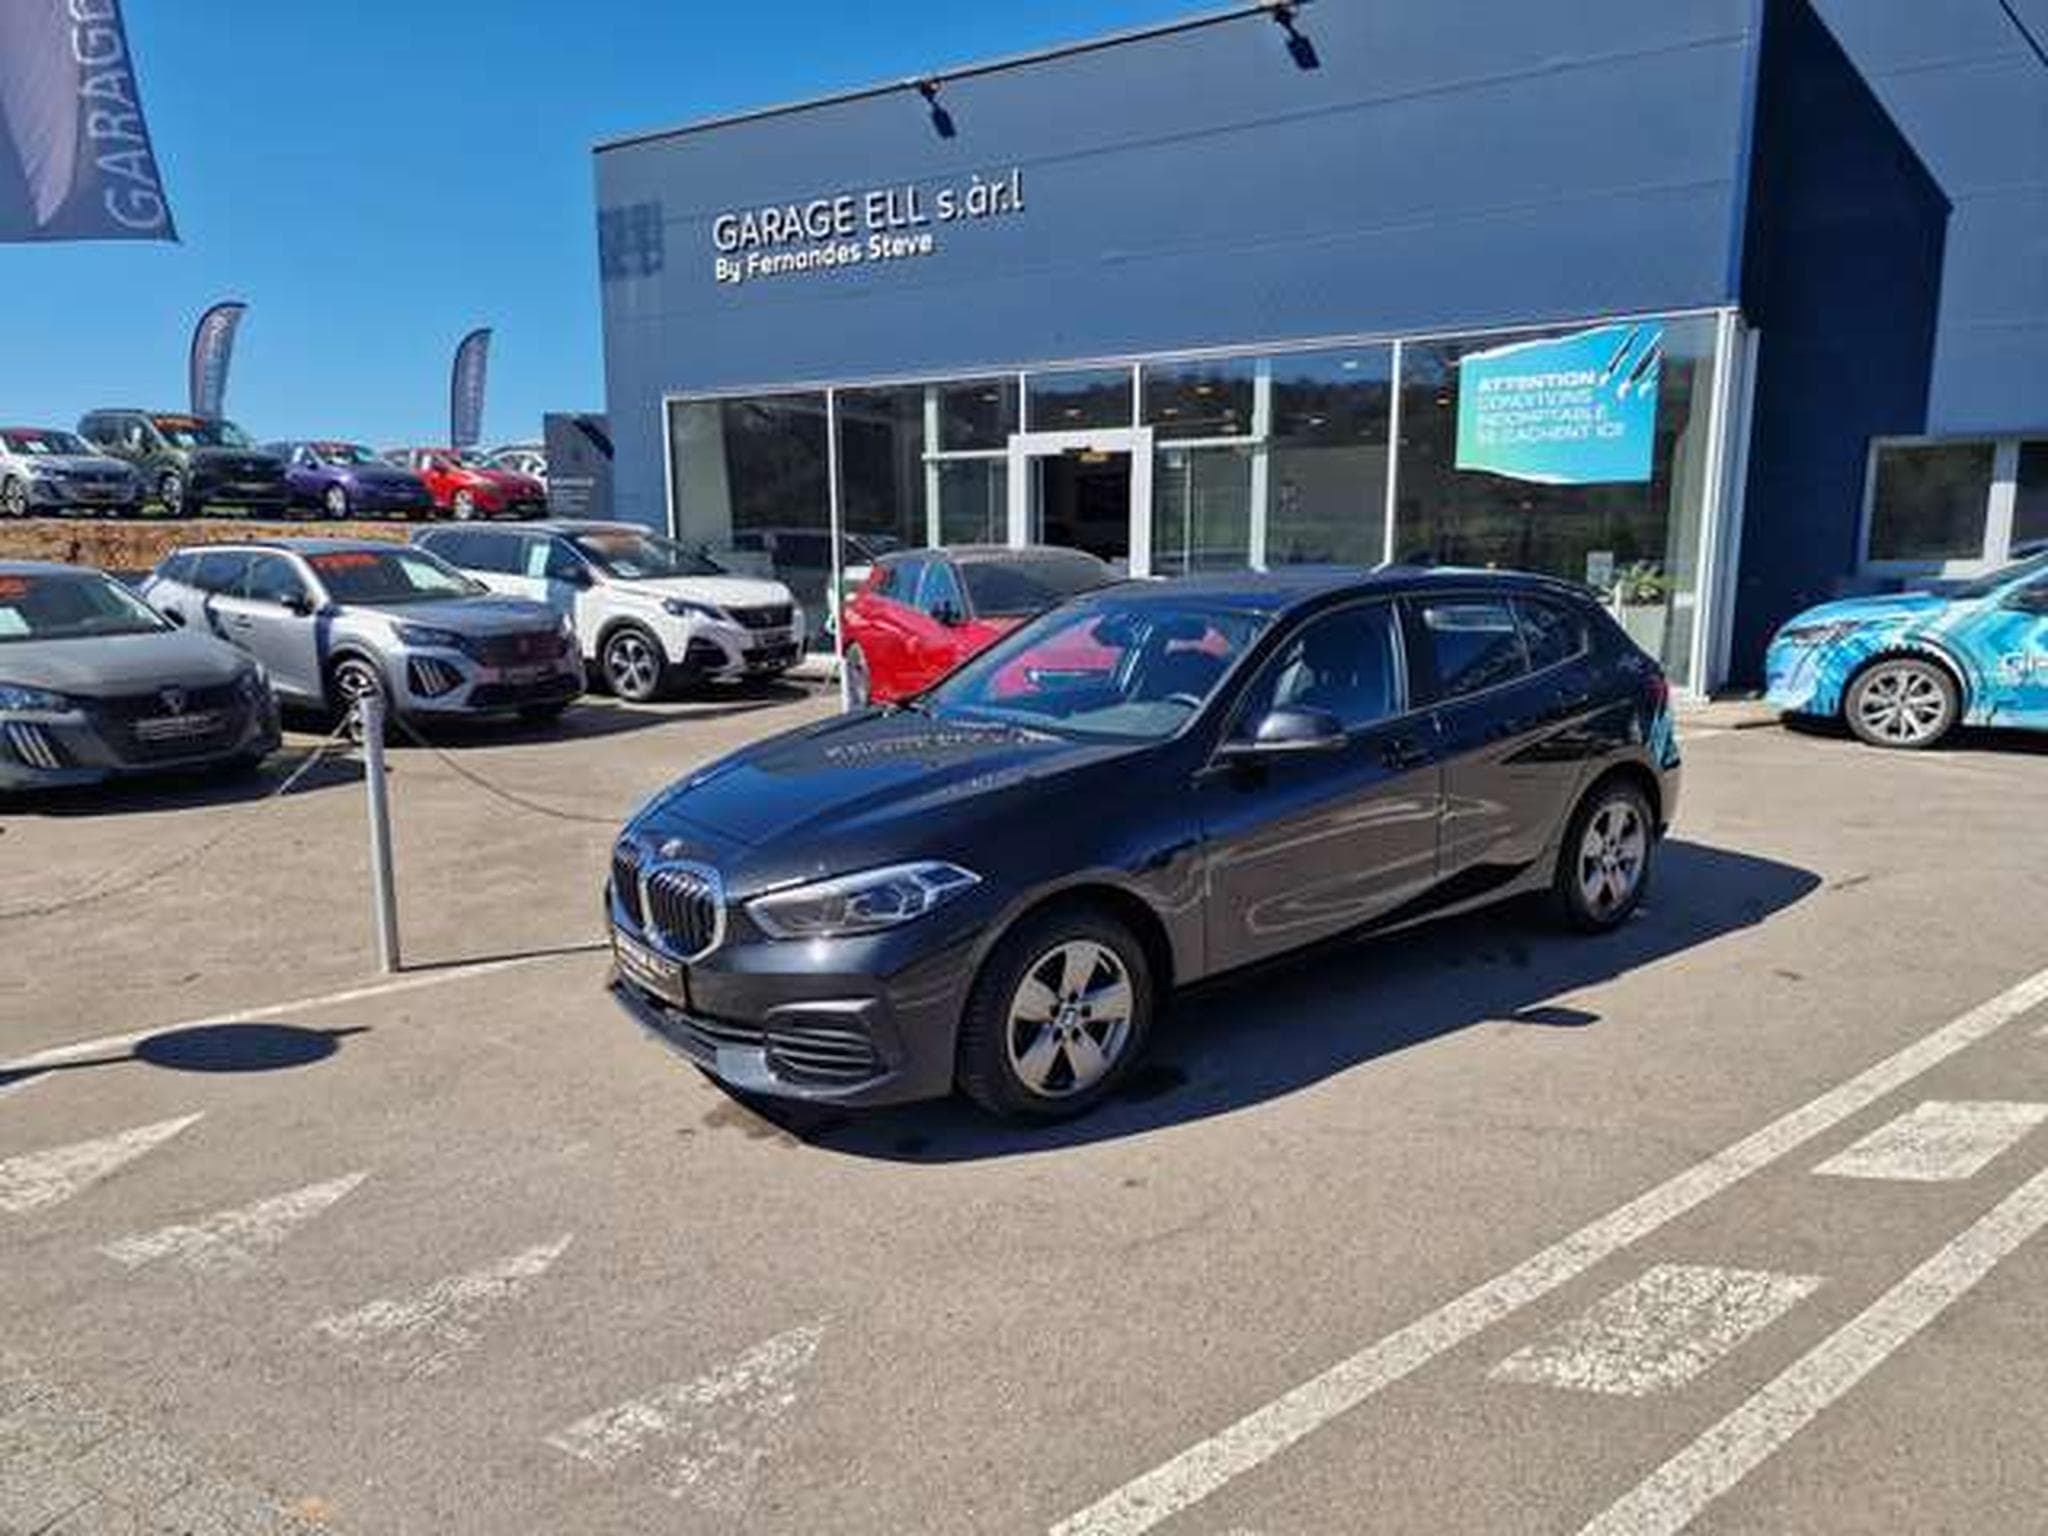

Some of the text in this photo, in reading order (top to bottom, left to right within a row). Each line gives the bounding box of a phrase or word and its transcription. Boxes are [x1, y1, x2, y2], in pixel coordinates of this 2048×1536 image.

[712, 195, 854, 251] GARAGE
[865, 185, 928, 228] ELL
[715, 231, 933, 283] By Fernandes Steve
[1478, 370, 1597, 393] ATTENTION
